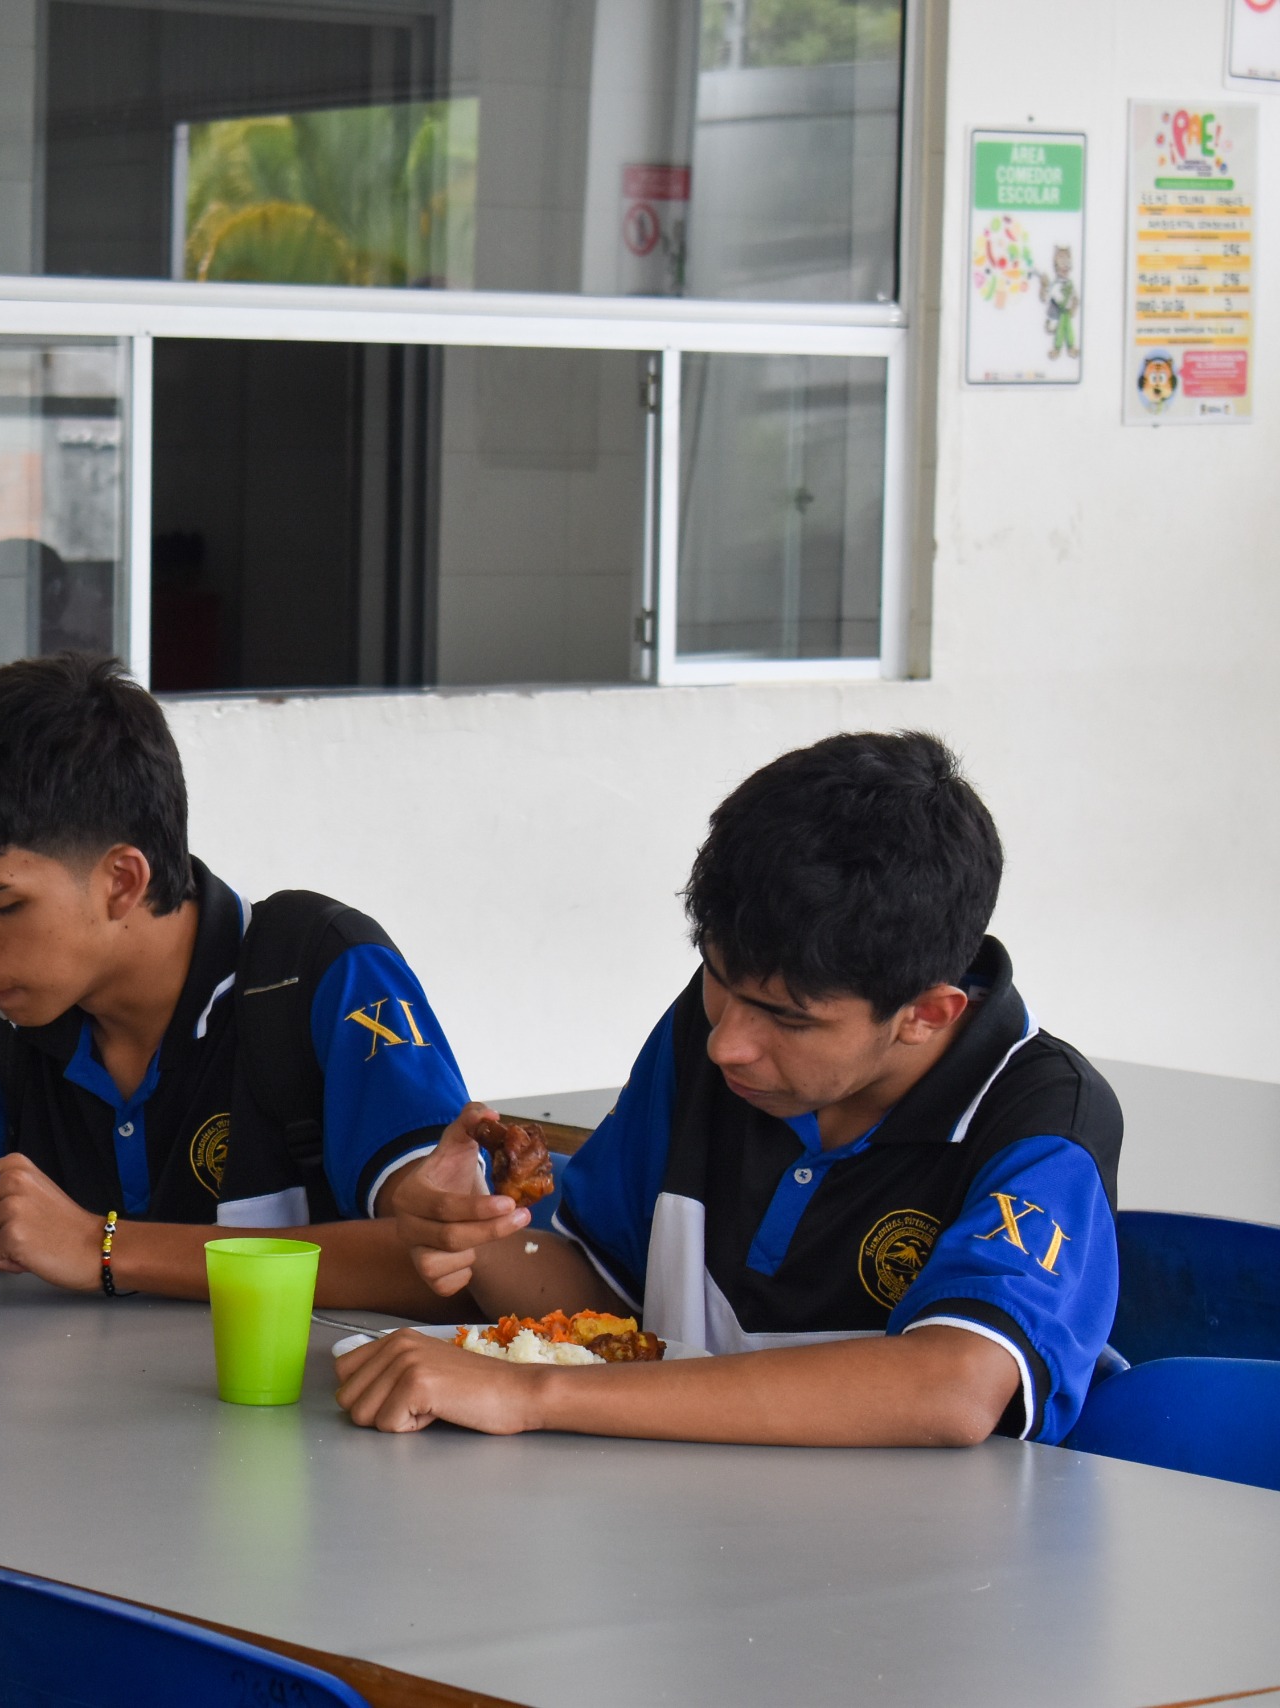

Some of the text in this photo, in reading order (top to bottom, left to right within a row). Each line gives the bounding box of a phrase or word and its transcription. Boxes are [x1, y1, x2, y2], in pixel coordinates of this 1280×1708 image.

[995, 164, 1064, 185] COMEDOR
[997, 185, 1061, 204] ESCOLAR
[344, 997, 431, 1061] XI
[974, 1192, 1071, 1275] XI
